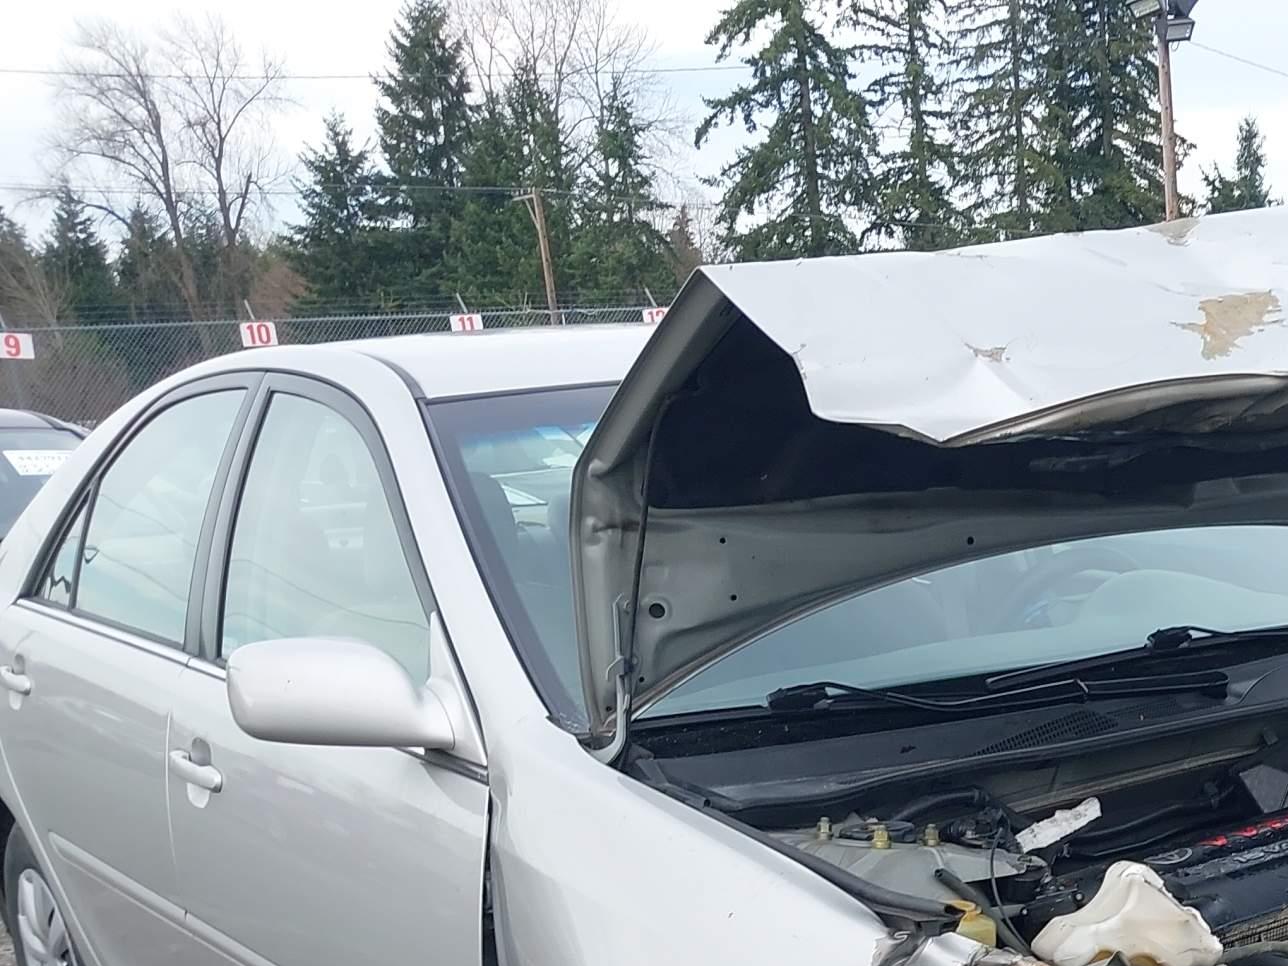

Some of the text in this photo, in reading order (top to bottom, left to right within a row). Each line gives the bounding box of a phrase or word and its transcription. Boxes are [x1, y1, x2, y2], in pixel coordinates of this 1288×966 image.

[245, 323, 272, 345] 10
[458, 315, 475, 331] 11
[4, 334, 21, 357] 9
